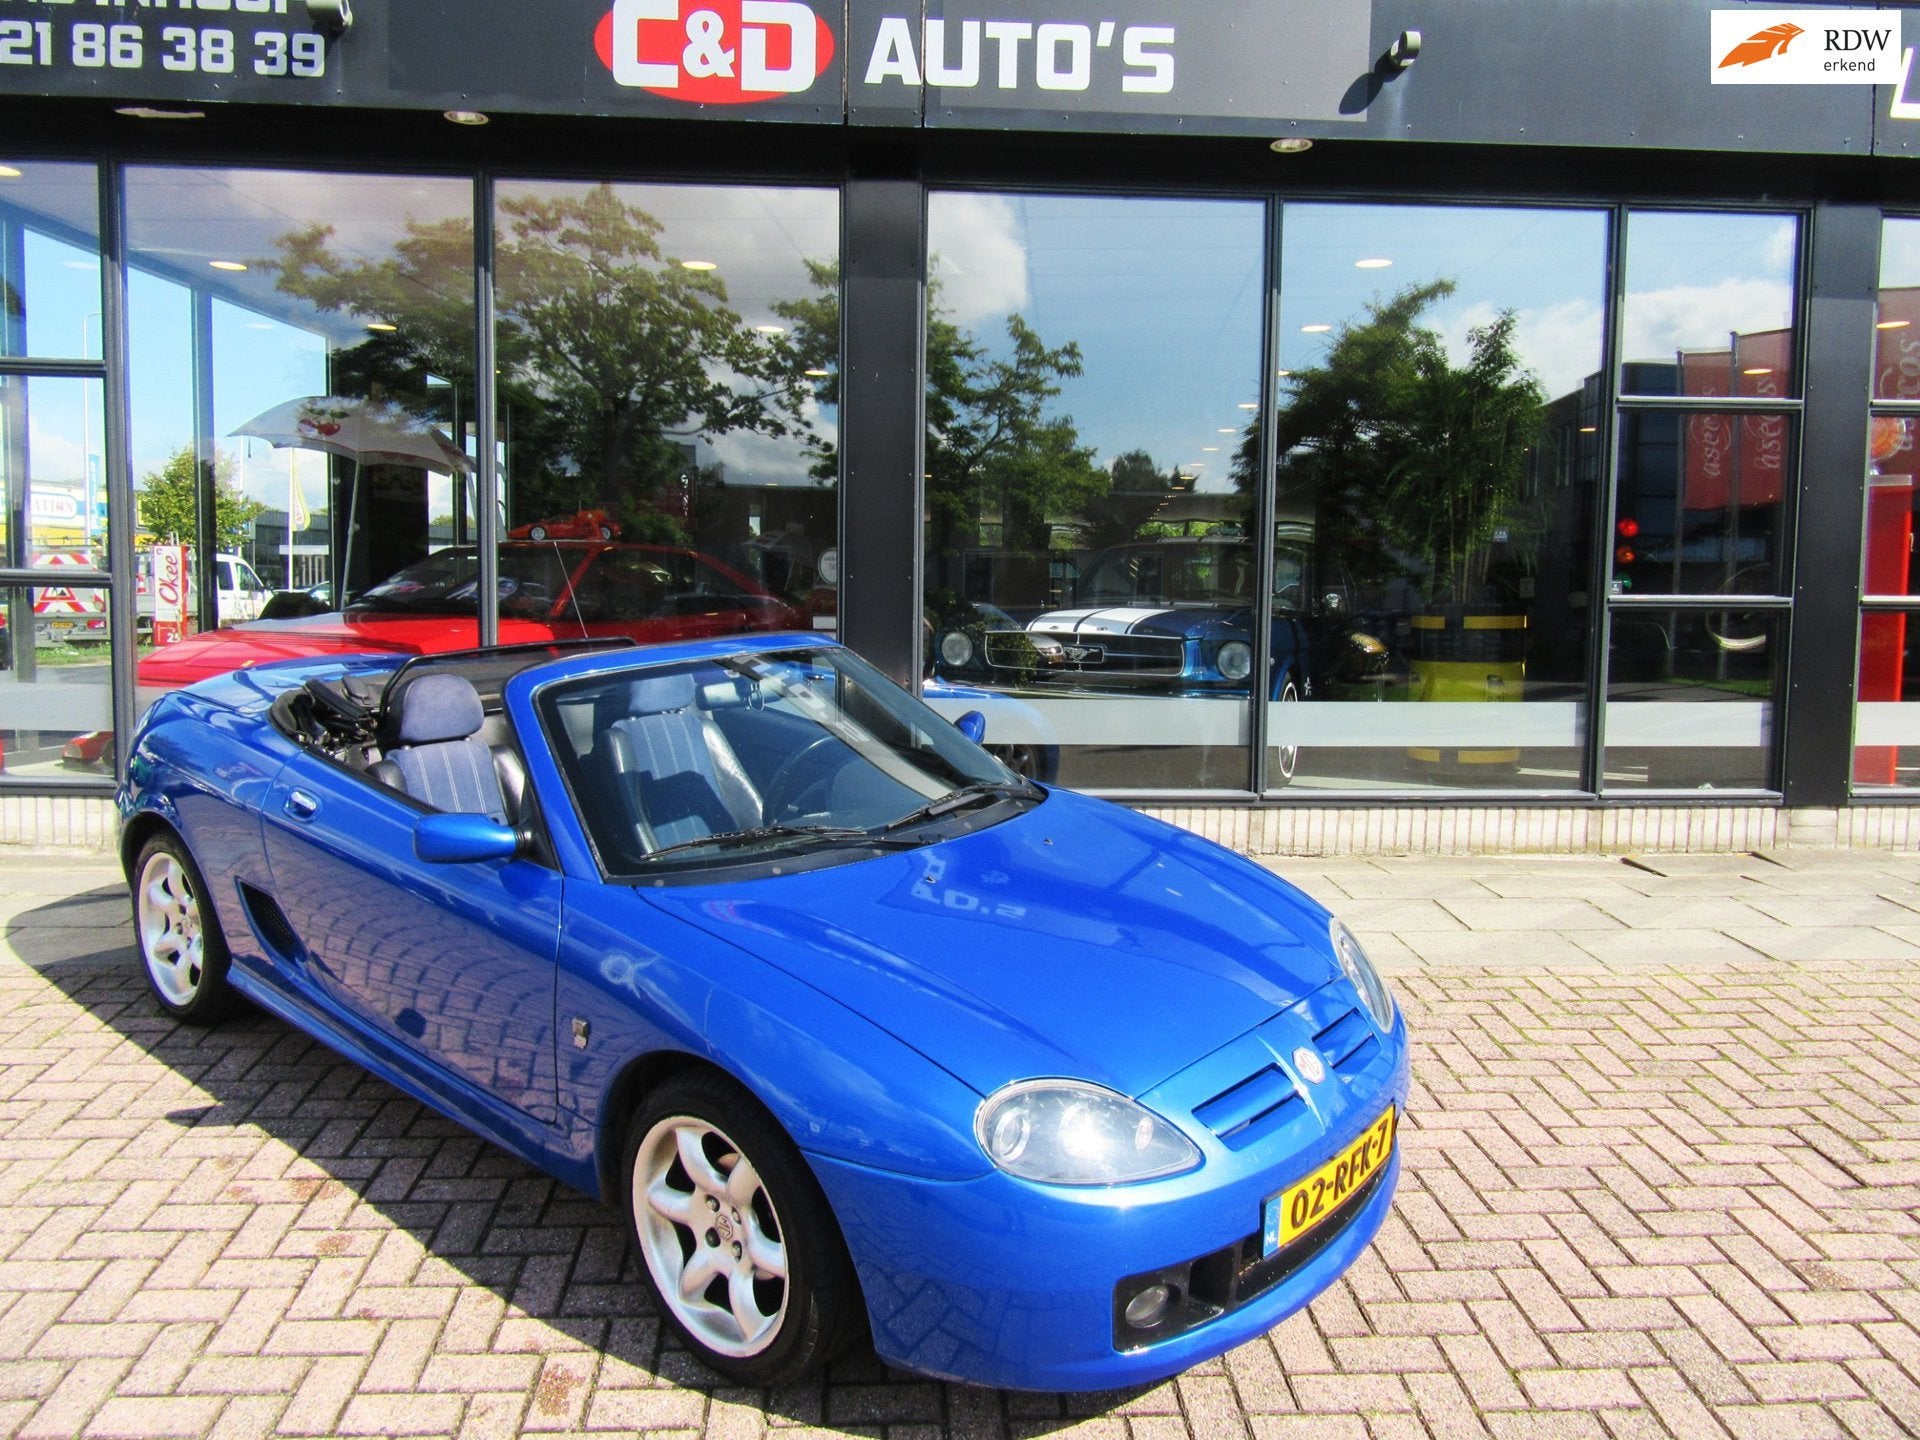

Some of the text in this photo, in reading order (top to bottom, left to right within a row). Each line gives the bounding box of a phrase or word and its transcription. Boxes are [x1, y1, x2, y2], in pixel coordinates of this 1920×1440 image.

[72, 23, 143, 68] 86
[162, 26, 234, 74] 38
[254, 31, 325, 77] 39
[612, 0, 1175, 93] C&D AUTO'S
[1290, 1118, 1389, 1230] 02-RFK-7
